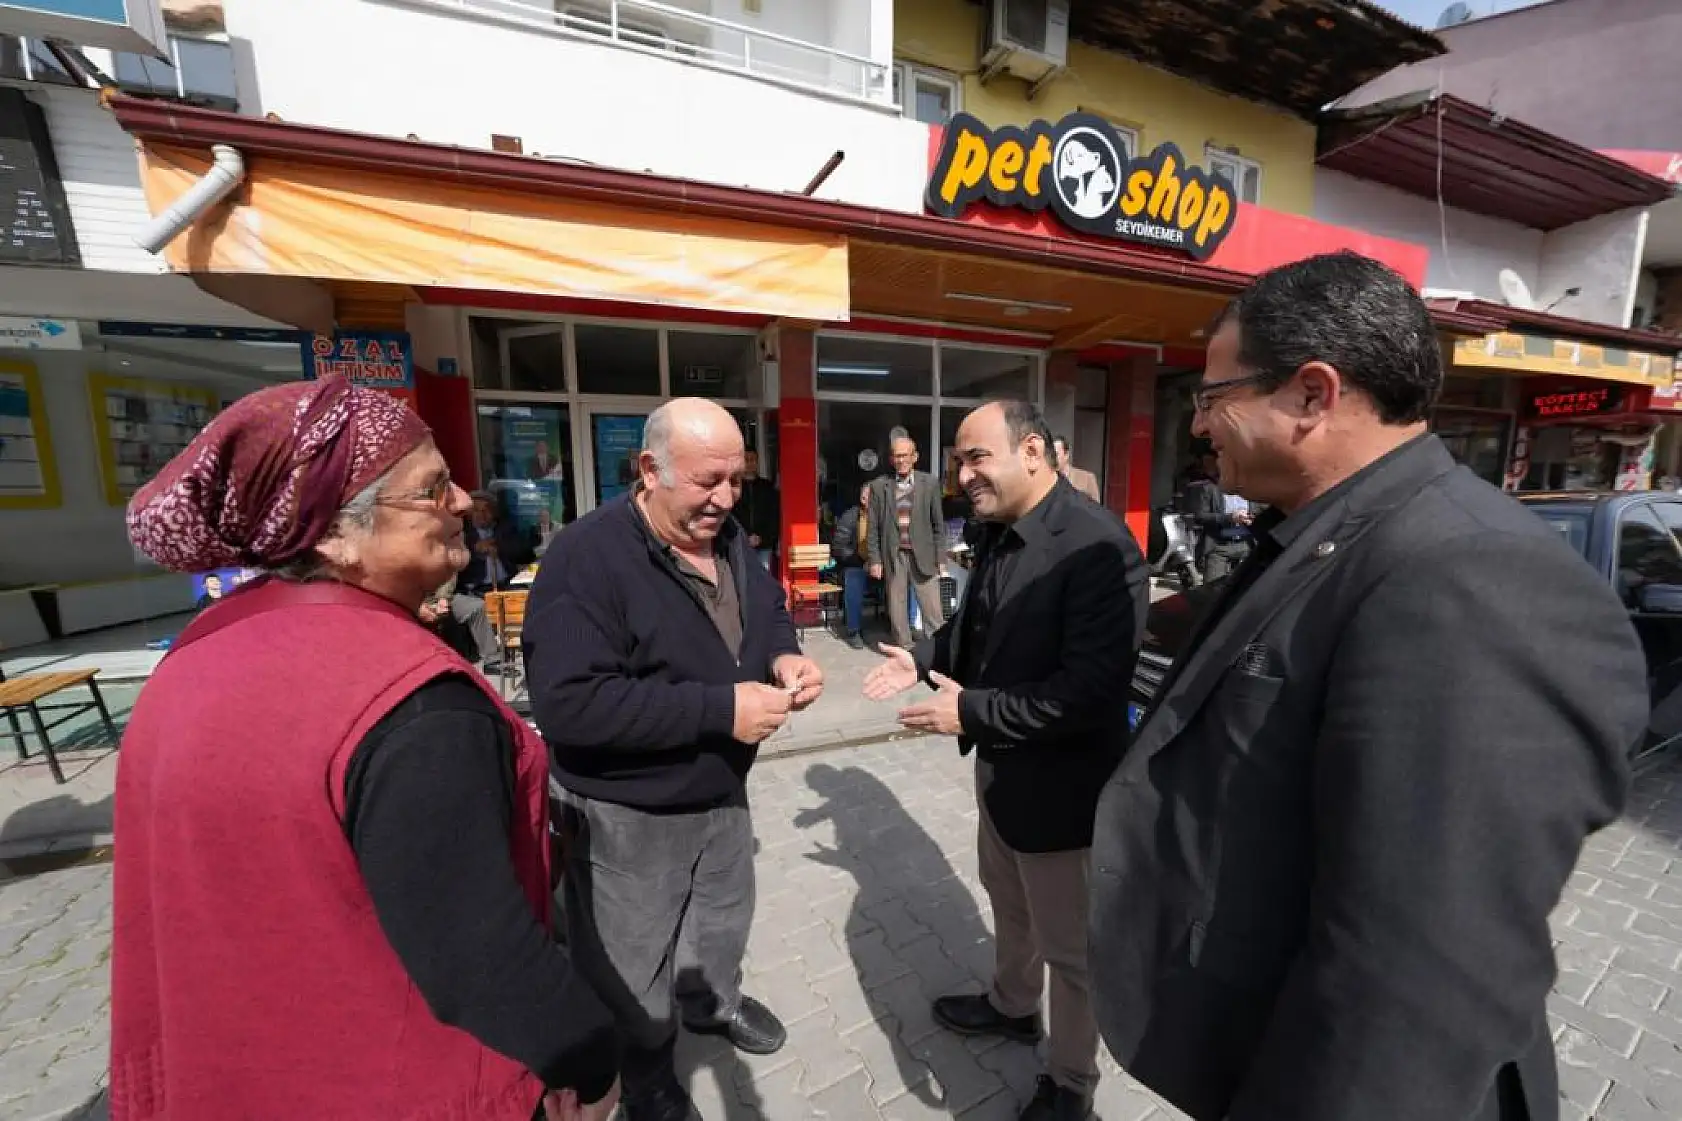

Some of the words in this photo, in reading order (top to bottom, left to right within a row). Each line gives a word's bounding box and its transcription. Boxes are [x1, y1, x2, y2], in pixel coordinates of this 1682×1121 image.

[941, 127, 1052, 204] pet
[1119, 154, 1230, 247] shop
[1115, 218, 1184, 244] SEYDİKEMER
